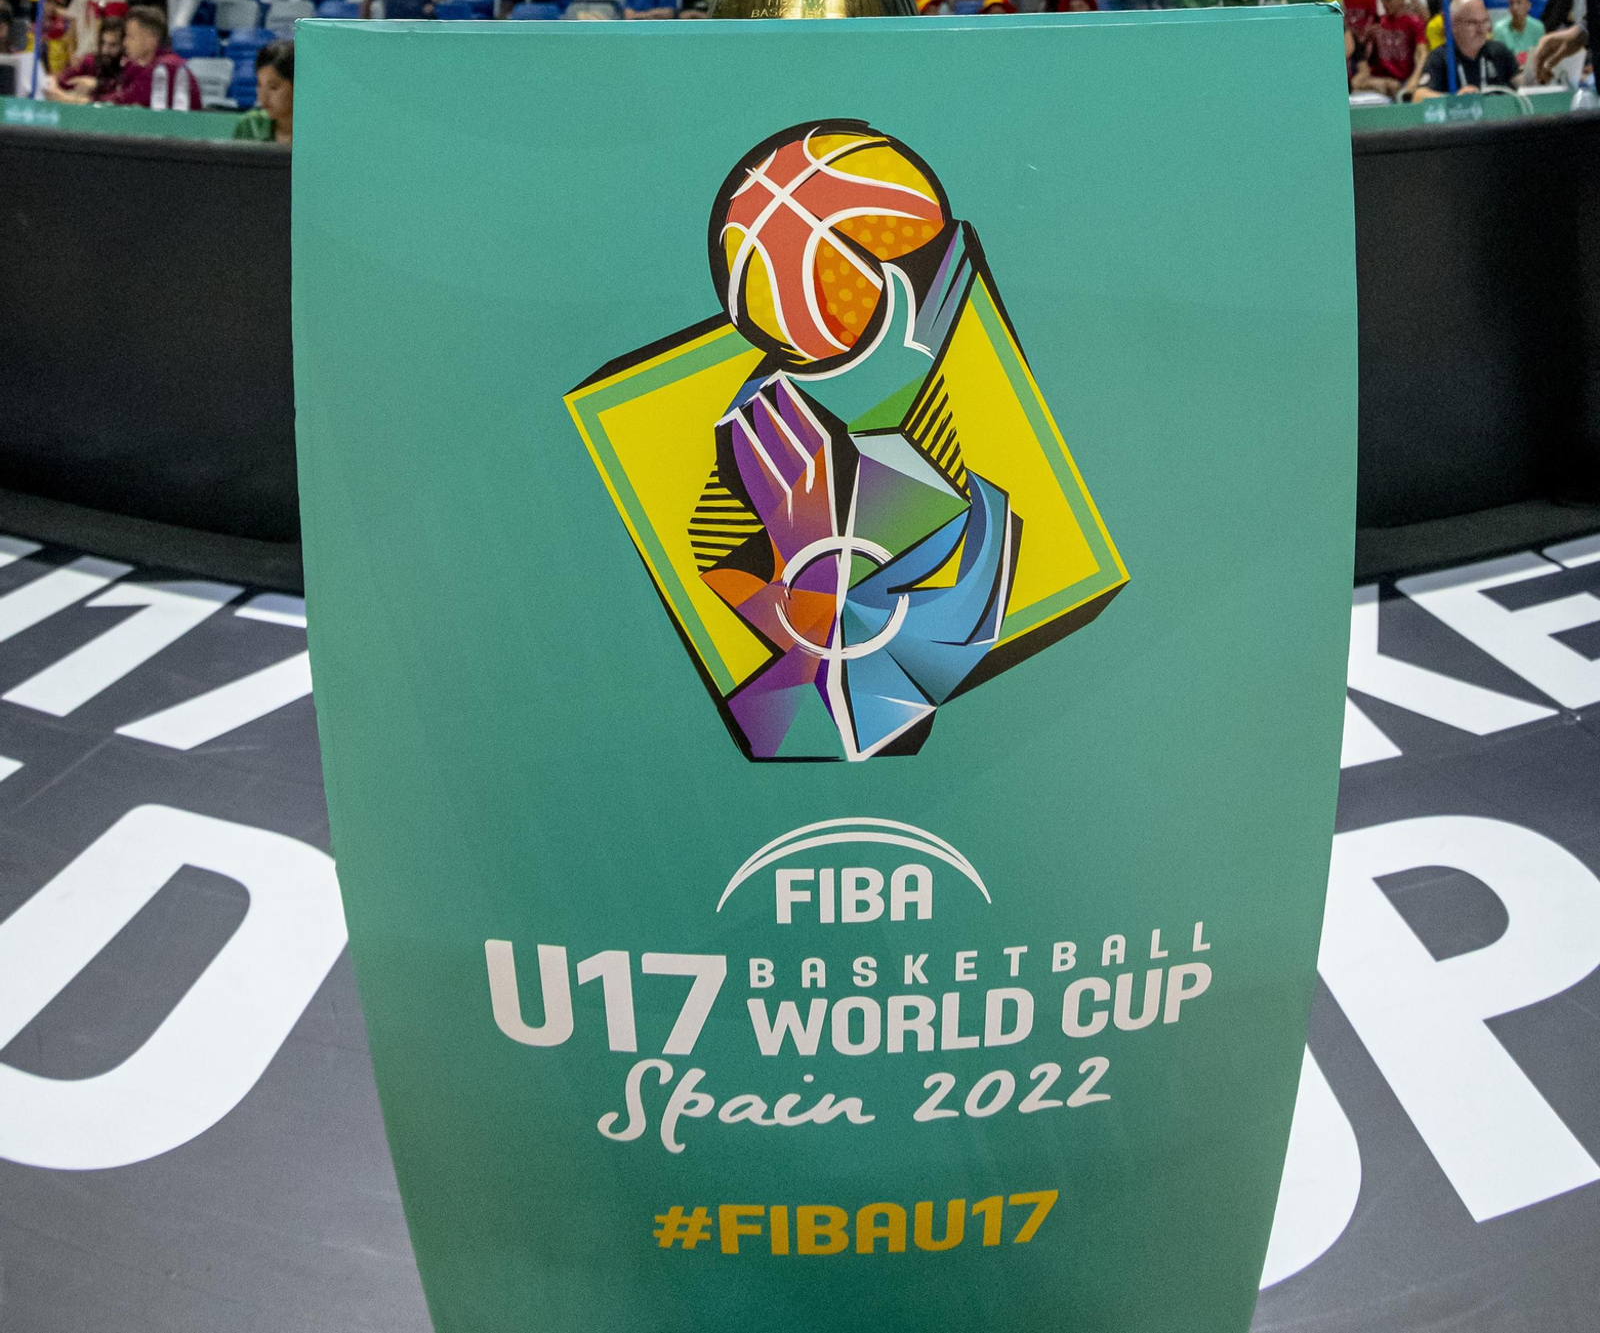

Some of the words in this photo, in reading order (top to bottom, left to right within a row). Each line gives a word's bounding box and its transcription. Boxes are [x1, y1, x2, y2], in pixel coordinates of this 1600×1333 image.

[775, 864, 933, 924] FIBA
[749, 921, 1211, 989] BASKETBALL
[484, 938, 728, 1056] U17
[746, 987, 1035, 1056] WORLD
[1061, 962, 1213, 1039] CUP
[597, 1058, 876, 1154] Spain
[913, 1056, 1112, 1122] 2022
[652, 1189, 1060, 1256] #FIBAU17
